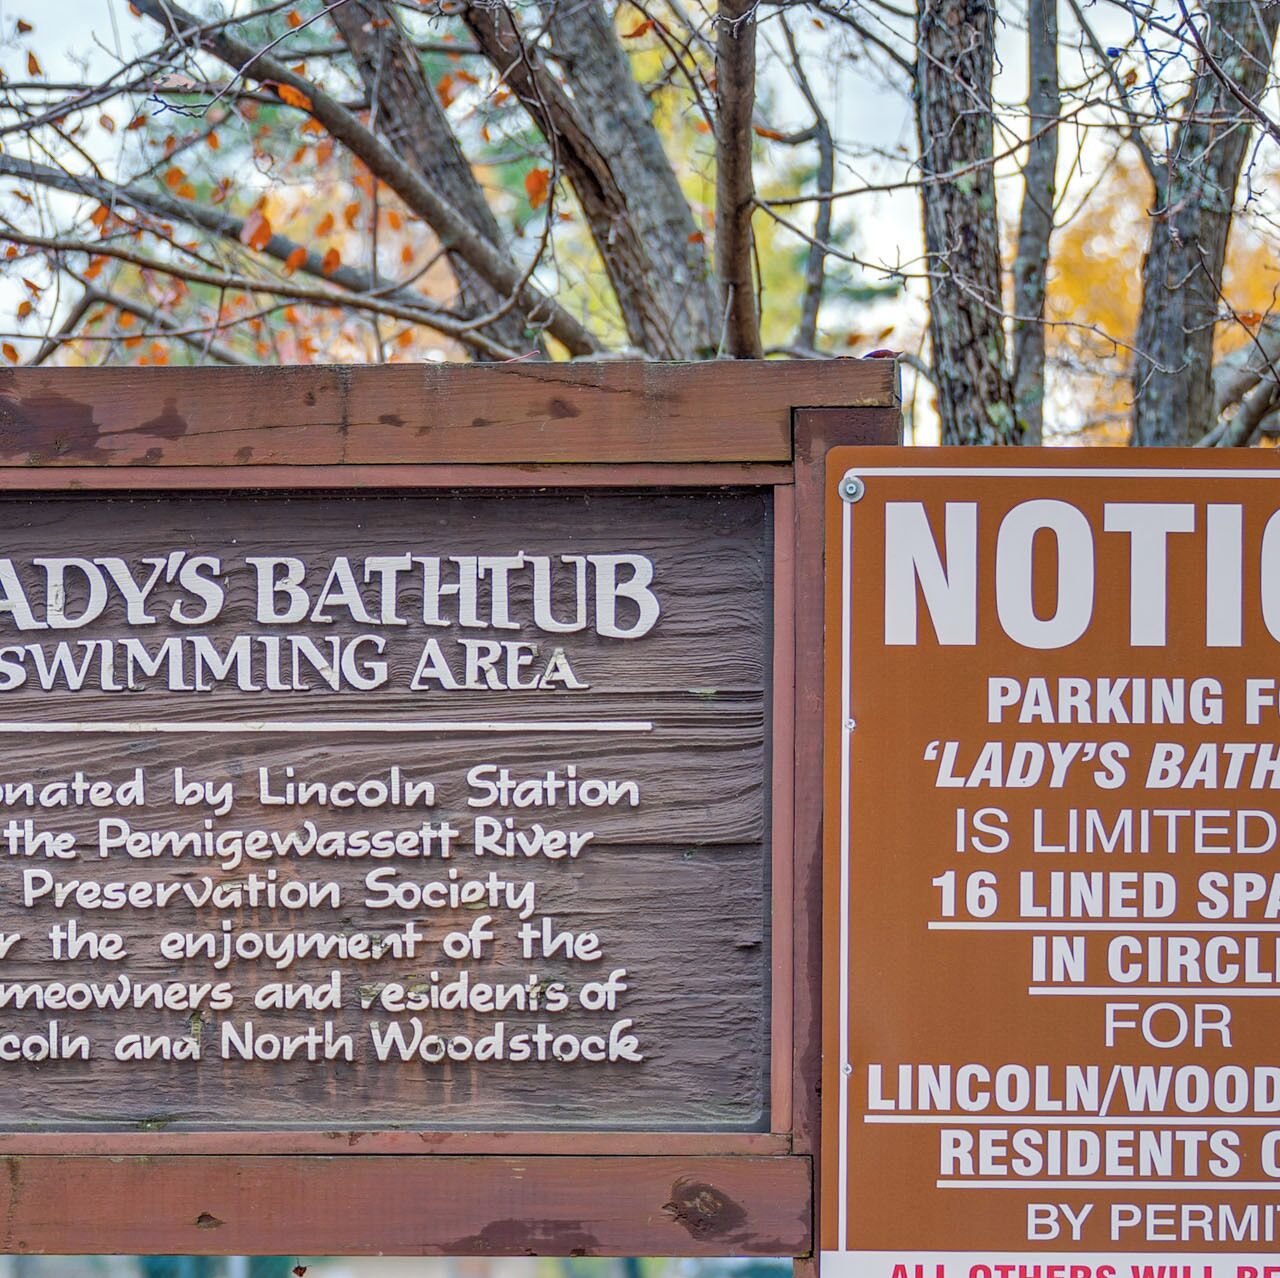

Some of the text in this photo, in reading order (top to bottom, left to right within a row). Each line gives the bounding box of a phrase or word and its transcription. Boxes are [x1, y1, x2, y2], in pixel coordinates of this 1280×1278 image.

[245, 550, 660, 639] BATHTUB
[410, 638, 590, 690] AREA
[988, 677, 1223, 725] PARKING
[174, 766, 233, 816] by
[258, 766, 435, 807] Lincoln
[466, 764, 639, 808] Station
[3, 818, 77, 859] the
[98, 817, 459, 870] Pemigewassett
[474, 815, 594, 858] River
[956, 807, 1010, 854] IS
[1034, 808, 1277, 854] LIMITED
[23, 866, 535, 920] Preservation Society
[932, 870, 998, 918] 16
[1020, 871, 1176, 918] LINED
[48, 918, 128, 960] the
[160, 919, 423, 969] enjoyment
[442, 914, 494, 959] of
[517, 916, 603, 961] the
[1032, 936, 1085, 982] IN
[254, 969, 341, 1010] and
[579, 968, 628, 1011] of
[221, 1020, 353, 1061] North
[369, 1016, 644, 1062] Woodstock
[1105, 1002, 1233, 1048] FOR
[940, 1129, 1240, 1178] RESIDENTS
[1027, 1203, 1094, 1241] BY
